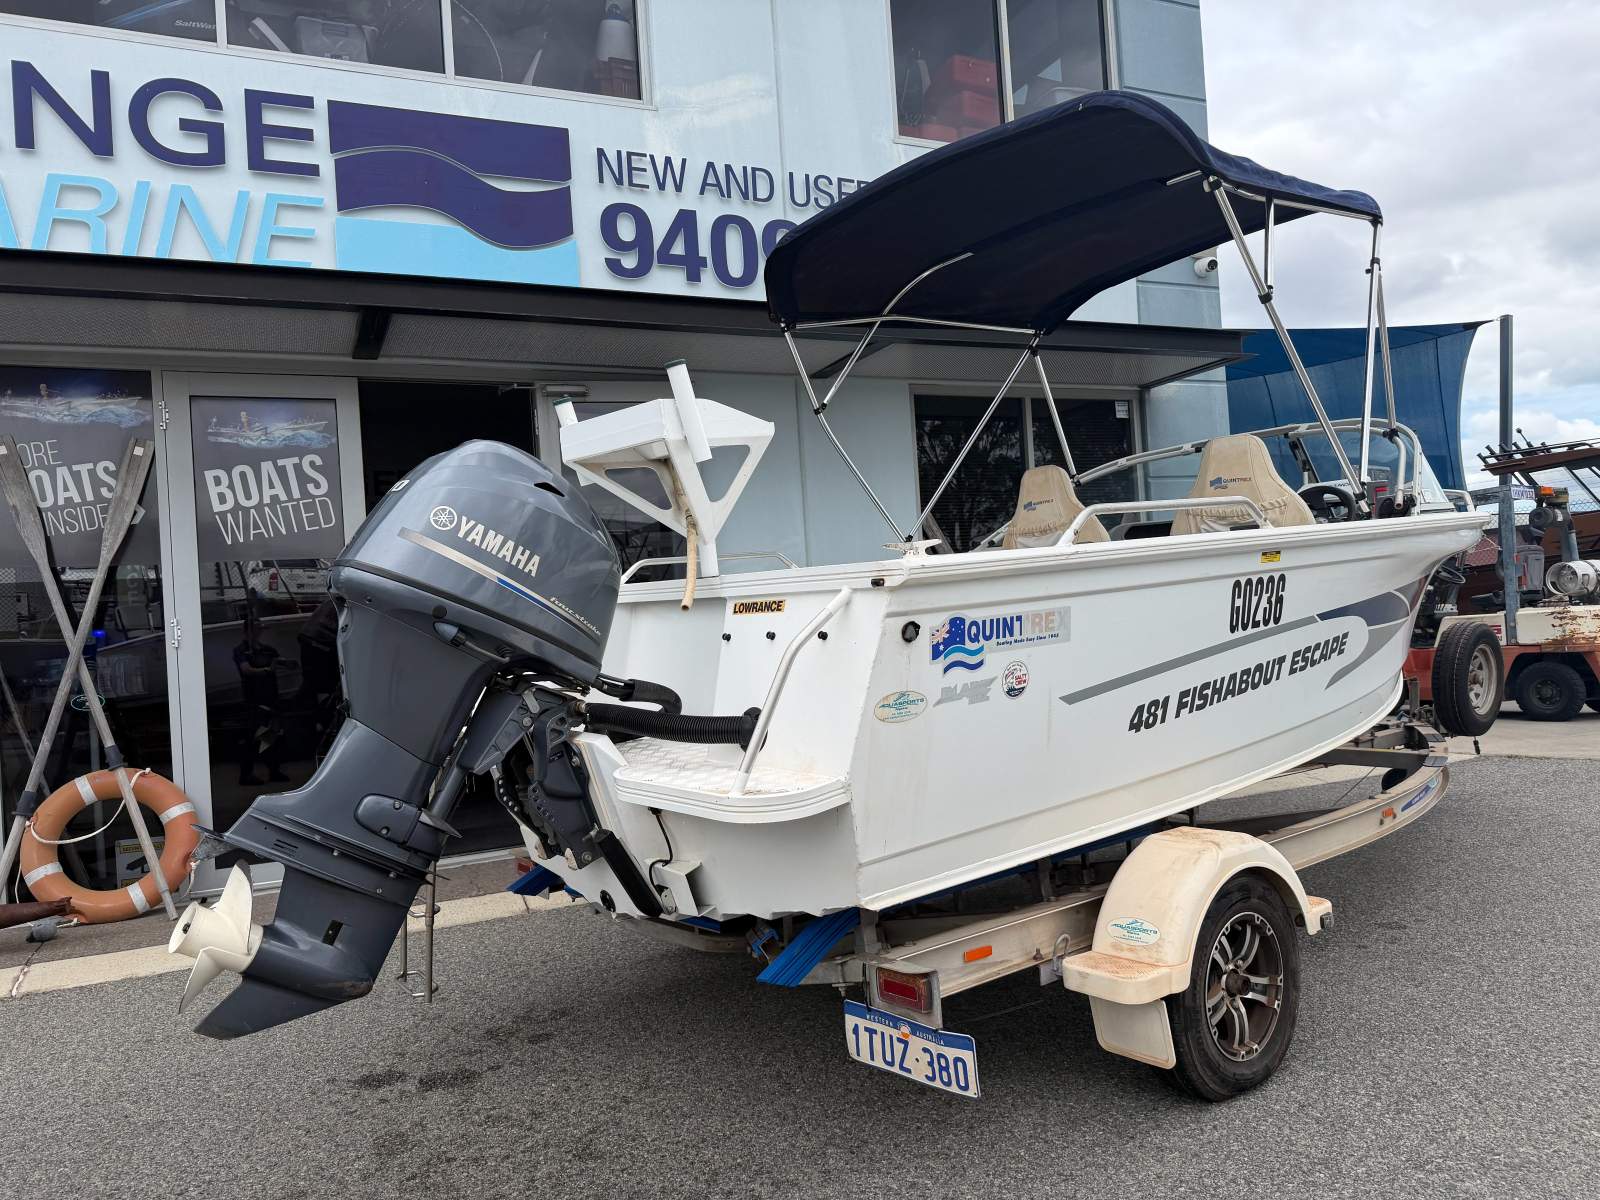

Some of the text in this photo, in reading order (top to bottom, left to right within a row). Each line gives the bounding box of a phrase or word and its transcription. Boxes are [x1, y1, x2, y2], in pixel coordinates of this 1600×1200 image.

[596, 147, 871, 209] NEW AND USE
[17, 439, 63, 469] ORE
[28, 460, 117, 508] OATS
[204, 454, 329, 513] BOATS
[215, 496, 336, 546] WANTED
[457, 515, 541, 578] YAMAHA
[732, 600, 784, 614] LOWRANCE
[1128, 631, 1349, 734] 481 FISHABOUT ESCAPE
[866, 1014, 945, 1046] WESTERN AUSTRALIA
